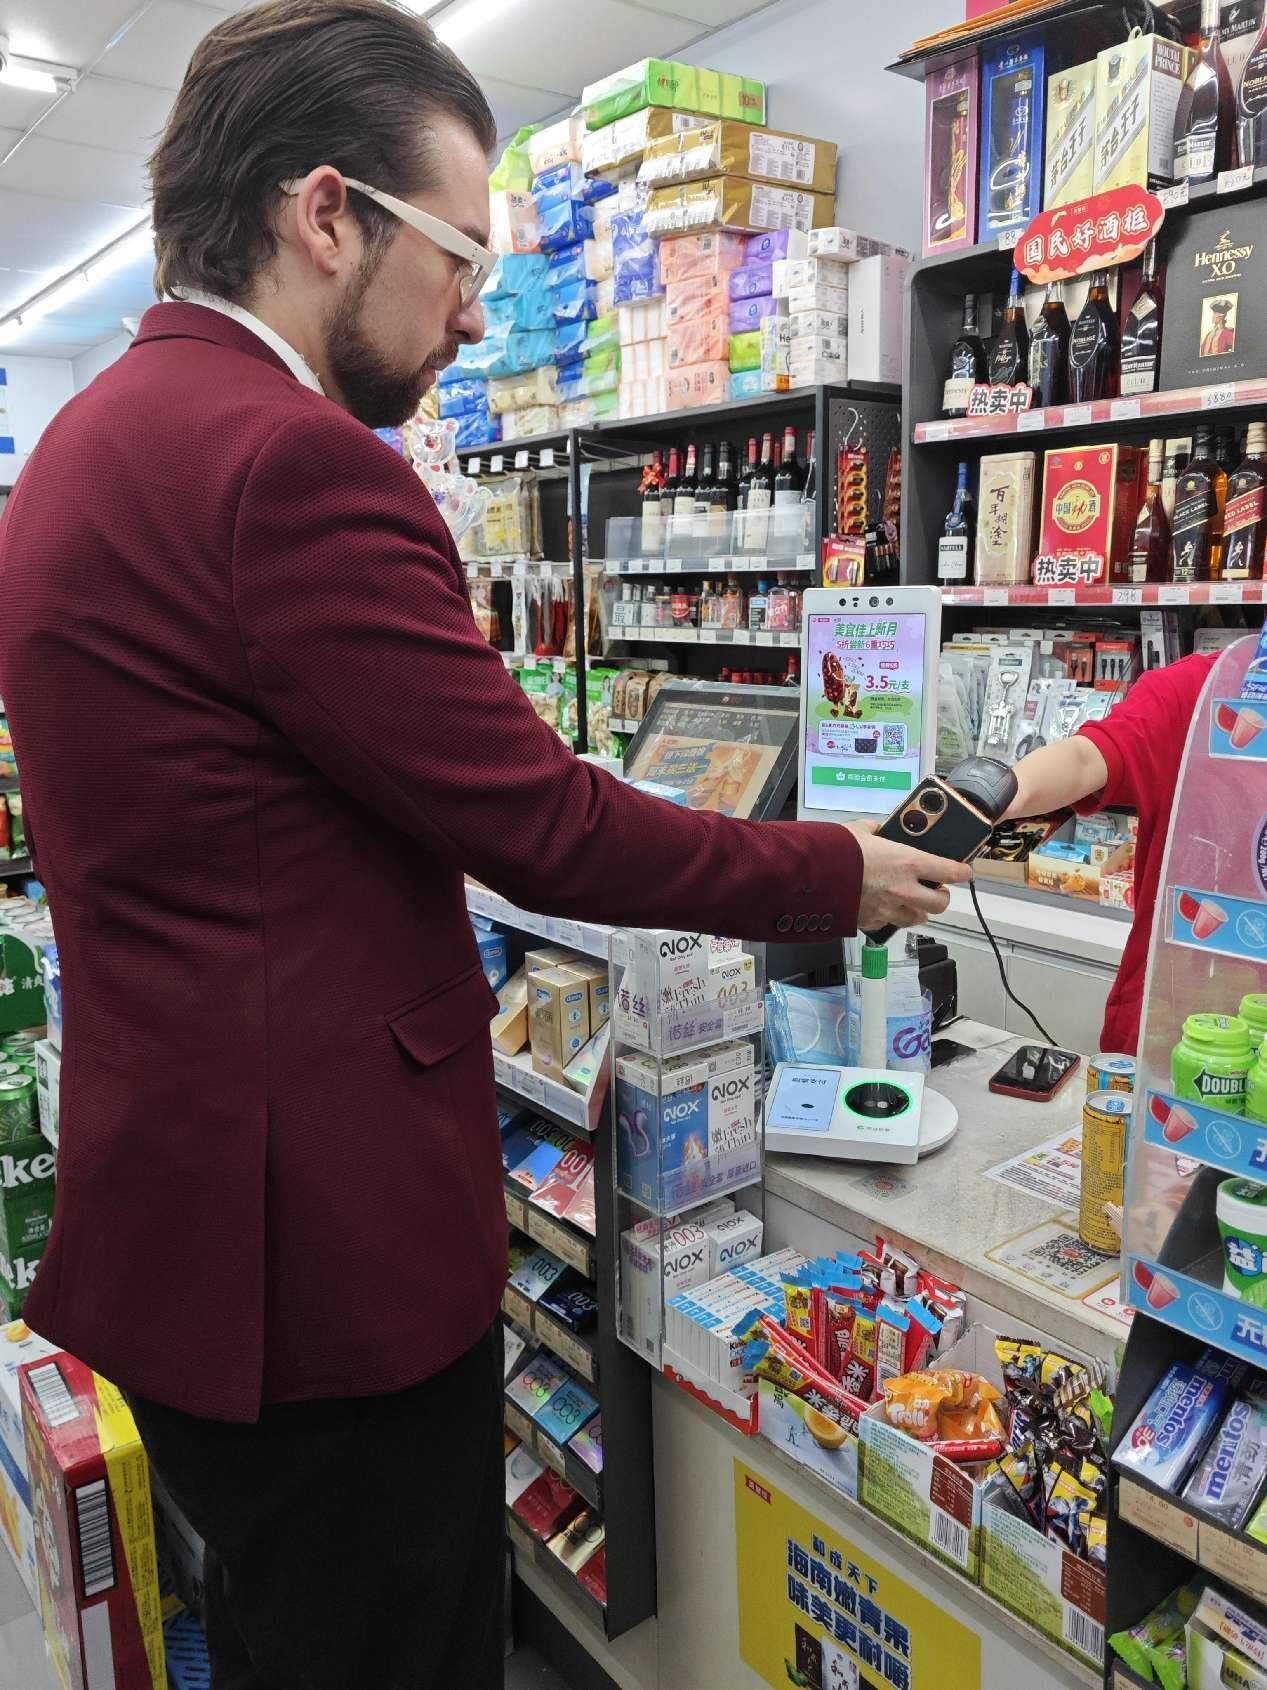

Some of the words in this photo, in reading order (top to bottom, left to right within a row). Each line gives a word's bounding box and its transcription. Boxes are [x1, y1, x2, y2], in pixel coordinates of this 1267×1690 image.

[1024, 205, 1149, 264] 国民好酒柜
[1194, 244, 1254, 267] Hennessy
[1211, 260, 1236, 278] XO
[968, 387, 1028, 414] 热卖中
[1237, 500, 1259, 514] LABEL
[1037, 556, 1100, 583] 热卖中
[660, 933, 703, 958] NOX
[711, 1076, 750, 1101] NOX
[1202, 1074, 1246, 1094] DOUBL
[663, 1099, 700, 1122] NOX
[717, 1216, 745, 1231] NOX
[720, 1233, 758, 1262] NOX
[531, 1258, 559, 1281] 003
[664, 1248, 703, 1277] NOX
[1156, 1375, 1206, 1448] mentos
[1205, 1402, 1252, 1500] mentos
[787, 1538, 910, 1660] 海南嫩青果
[787, 1571, 910, 1690] 味美更耐嚼
